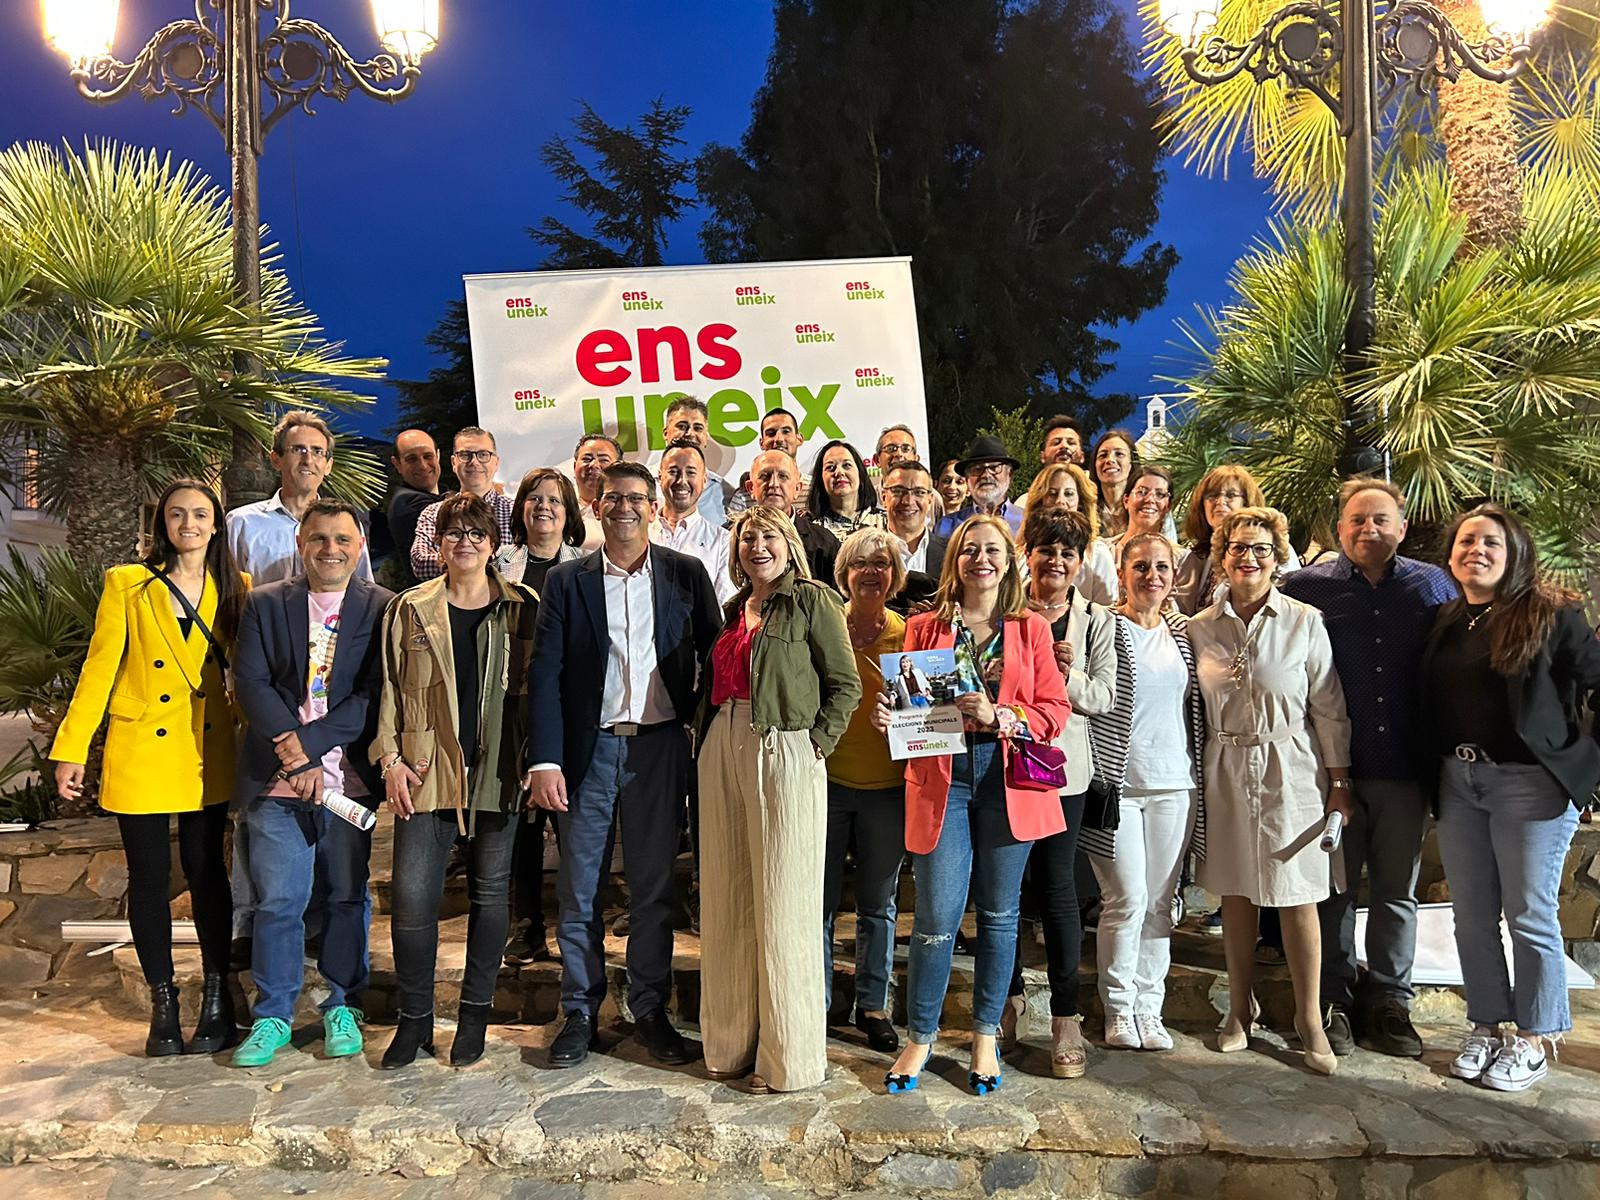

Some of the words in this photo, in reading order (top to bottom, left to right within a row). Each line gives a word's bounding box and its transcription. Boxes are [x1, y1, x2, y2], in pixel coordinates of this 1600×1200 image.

[735, 286, 761, 296] ens
[846, 281, 870, 291] ens
[622, 290, 648, 302] ens
[736, 293, 776, 306] uneix
[847, 287, 885, 301] uneix
[506, 297, 532, 308] ens
[623, 299, 664, 311] uneix
[506, 304, 548, 319] uneix
[795, 323, 820, 334] ens
[796, 330, 835, 344] uneix
[576, 323, 743, 387] ens
[855, 367, 880, 378] ens
[856, 374, 895, 388] uneix
[514, 389, 541, 401] ens
[515, 397, 556, 411] uneix
[892, 720, 922, 729] ELECCIONS
[923, 717, 957, 725] MUNICIPALS
[907, 740, 949, 752] ensuneix
